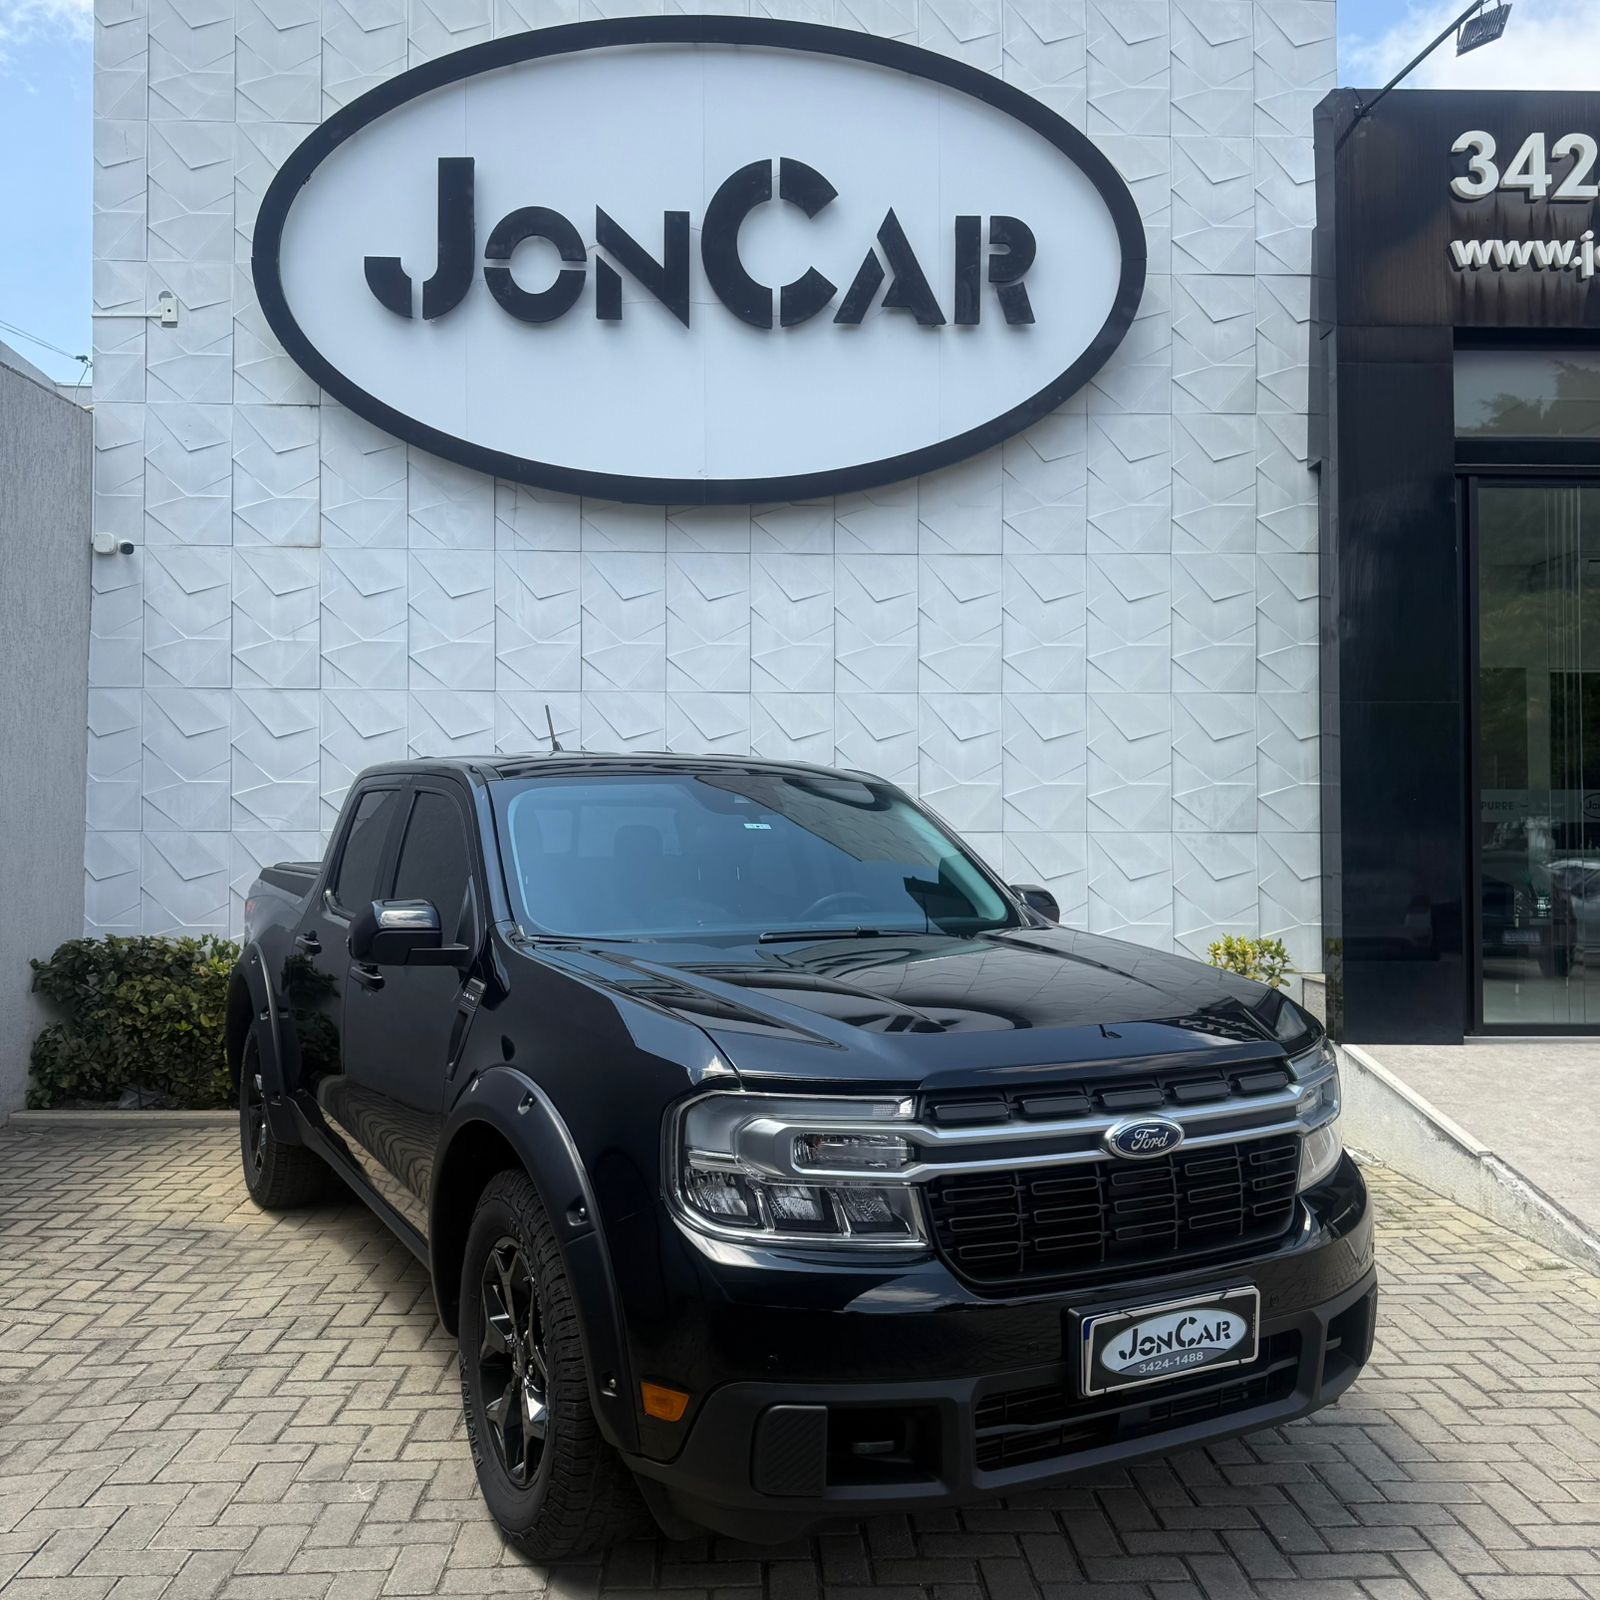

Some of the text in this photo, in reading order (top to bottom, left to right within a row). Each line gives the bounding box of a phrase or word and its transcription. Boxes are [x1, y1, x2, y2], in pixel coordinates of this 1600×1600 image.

[1450, 130, 1600, 200] 342
[1450, 230, 1600, 279] www.j
[1131, 1127, 1169, 1152] Ford
[1138, 1351, 1204, 1374] 3424-1488
